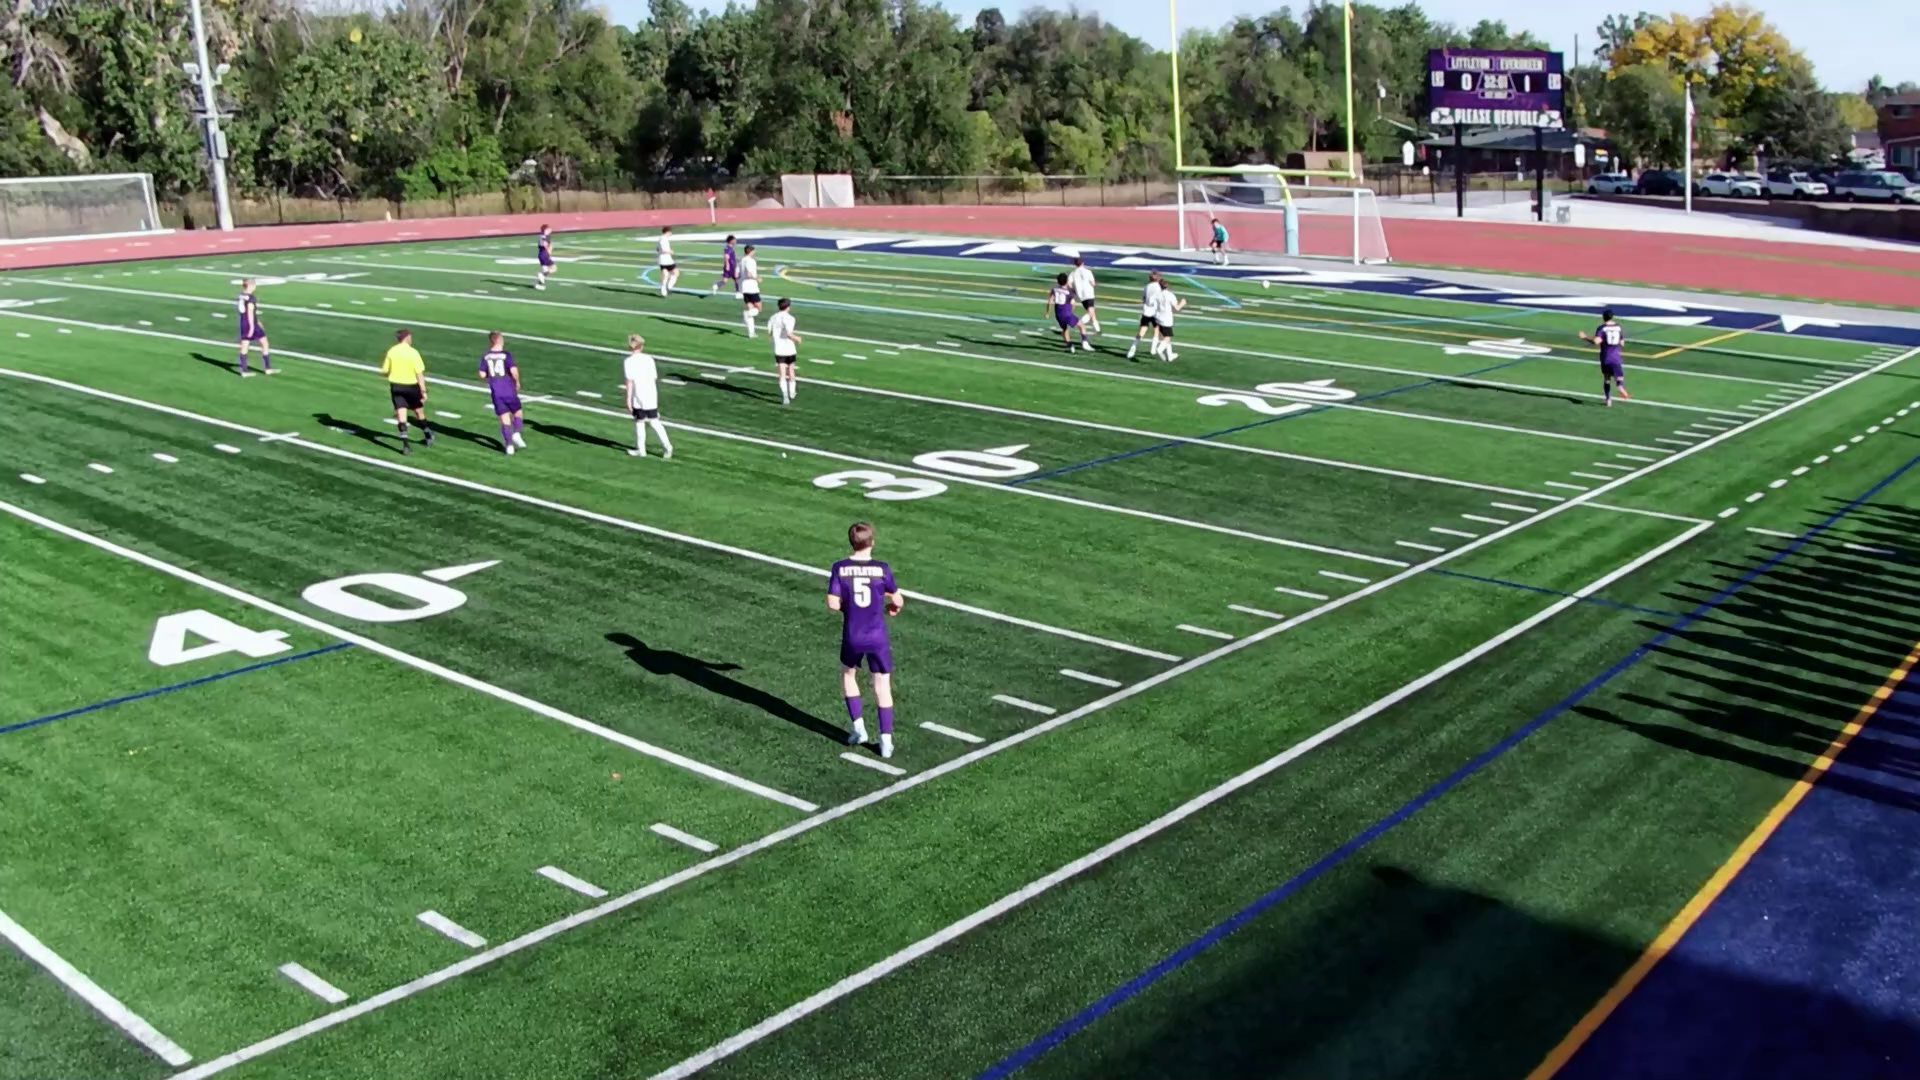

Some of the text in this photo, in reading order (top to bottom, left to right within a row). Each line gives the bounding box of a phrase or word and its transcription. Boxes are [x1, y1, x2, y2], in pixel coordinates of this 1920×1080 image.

[1461, 73, 1472, 91] 0
[1454, 108, 1491, 124] PLEASE
[487, 359, 505, 377] 14
[1197, 382, 1357, 415] 20
[812, 450, 1040, 500] 30
[853, 577, 871, 608] 5
[149, 572, 468, 666] 40
